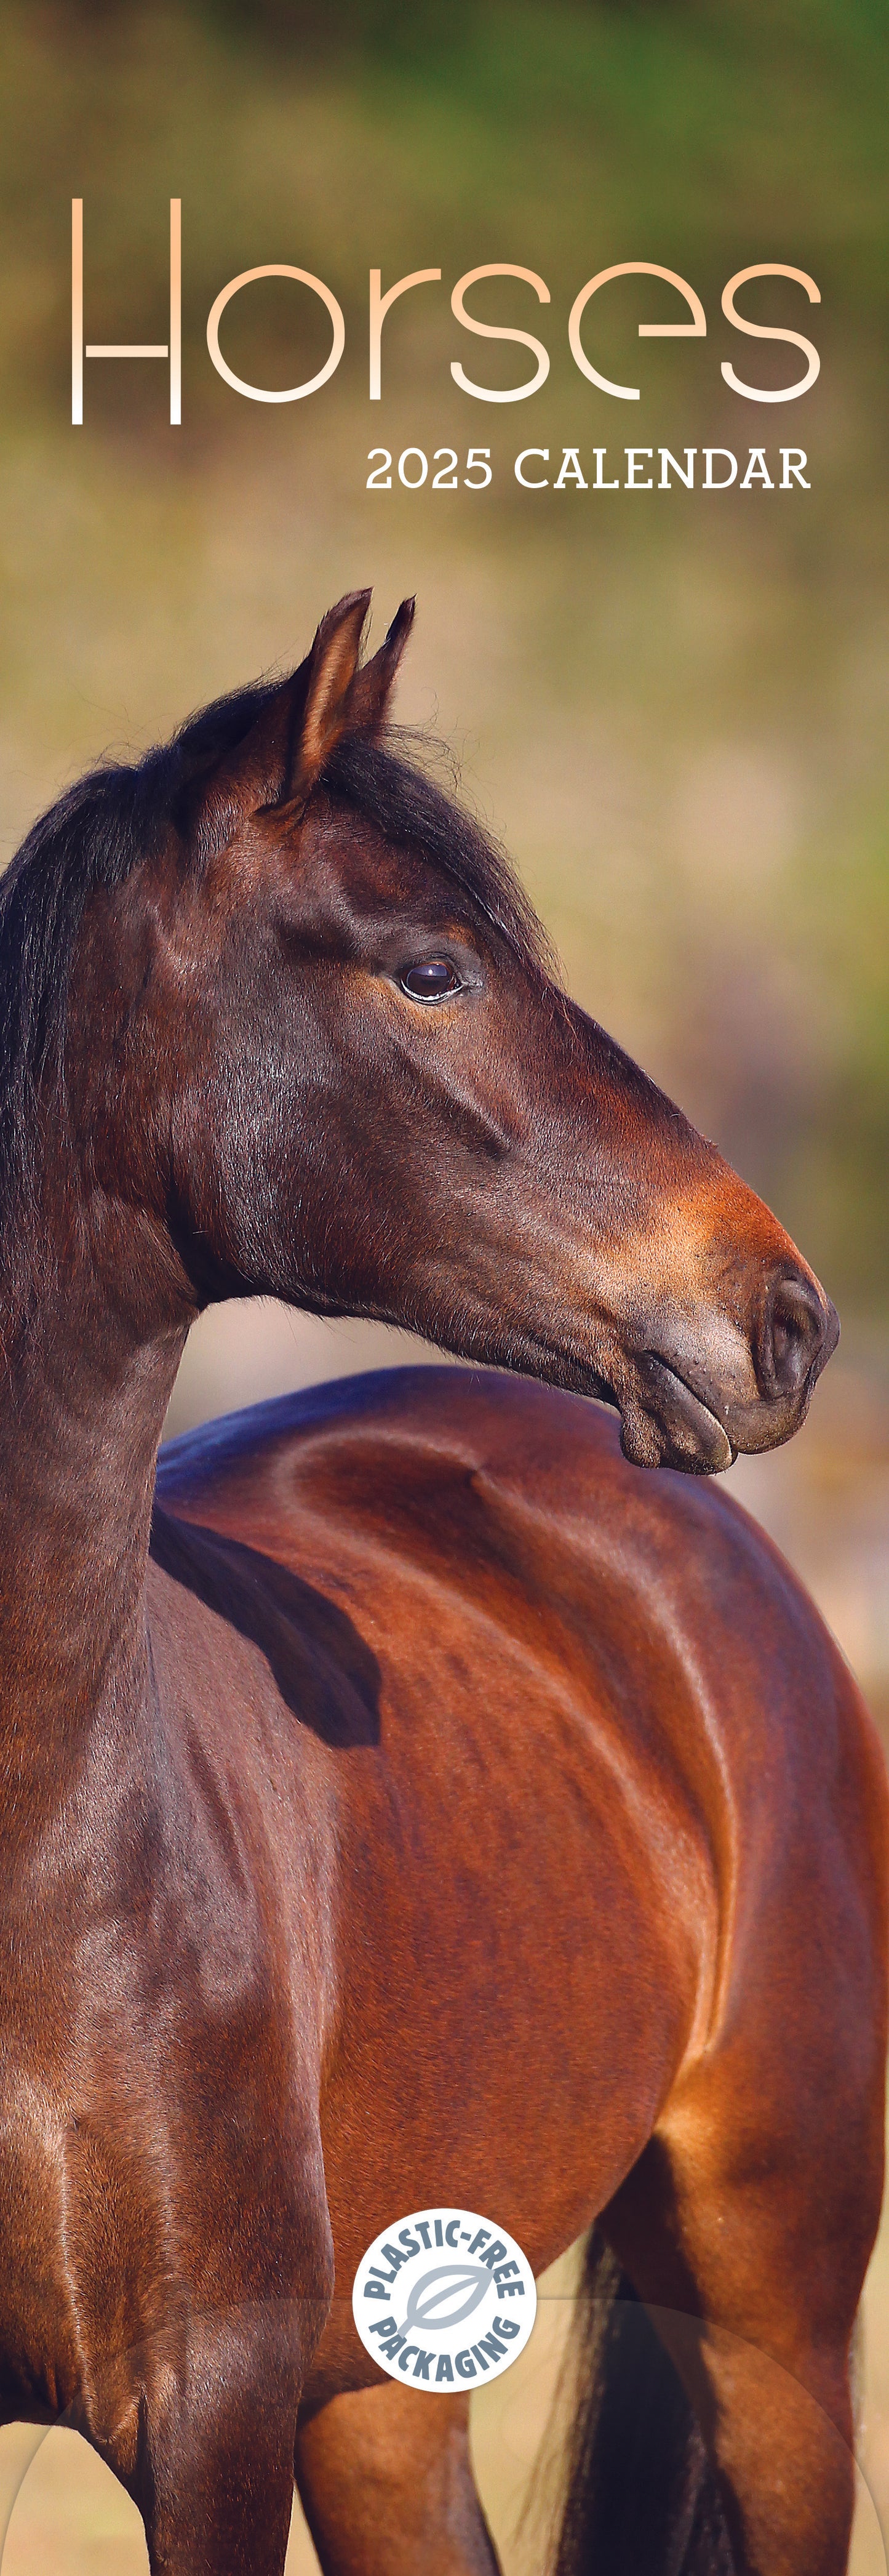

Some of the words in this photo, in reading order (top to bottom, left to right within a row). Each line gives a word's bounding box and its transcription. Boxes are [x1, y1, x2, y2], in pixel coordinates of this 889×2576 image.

[71, 198, 821, 425] Horses
[365, 447, 493, 489] 2025
[513, 447, 811, 489] CALENDAR
[364, 2220, 525, 2300] PLASTIC-FREE
[368, 2316, 520, 2381] PACKAGING
